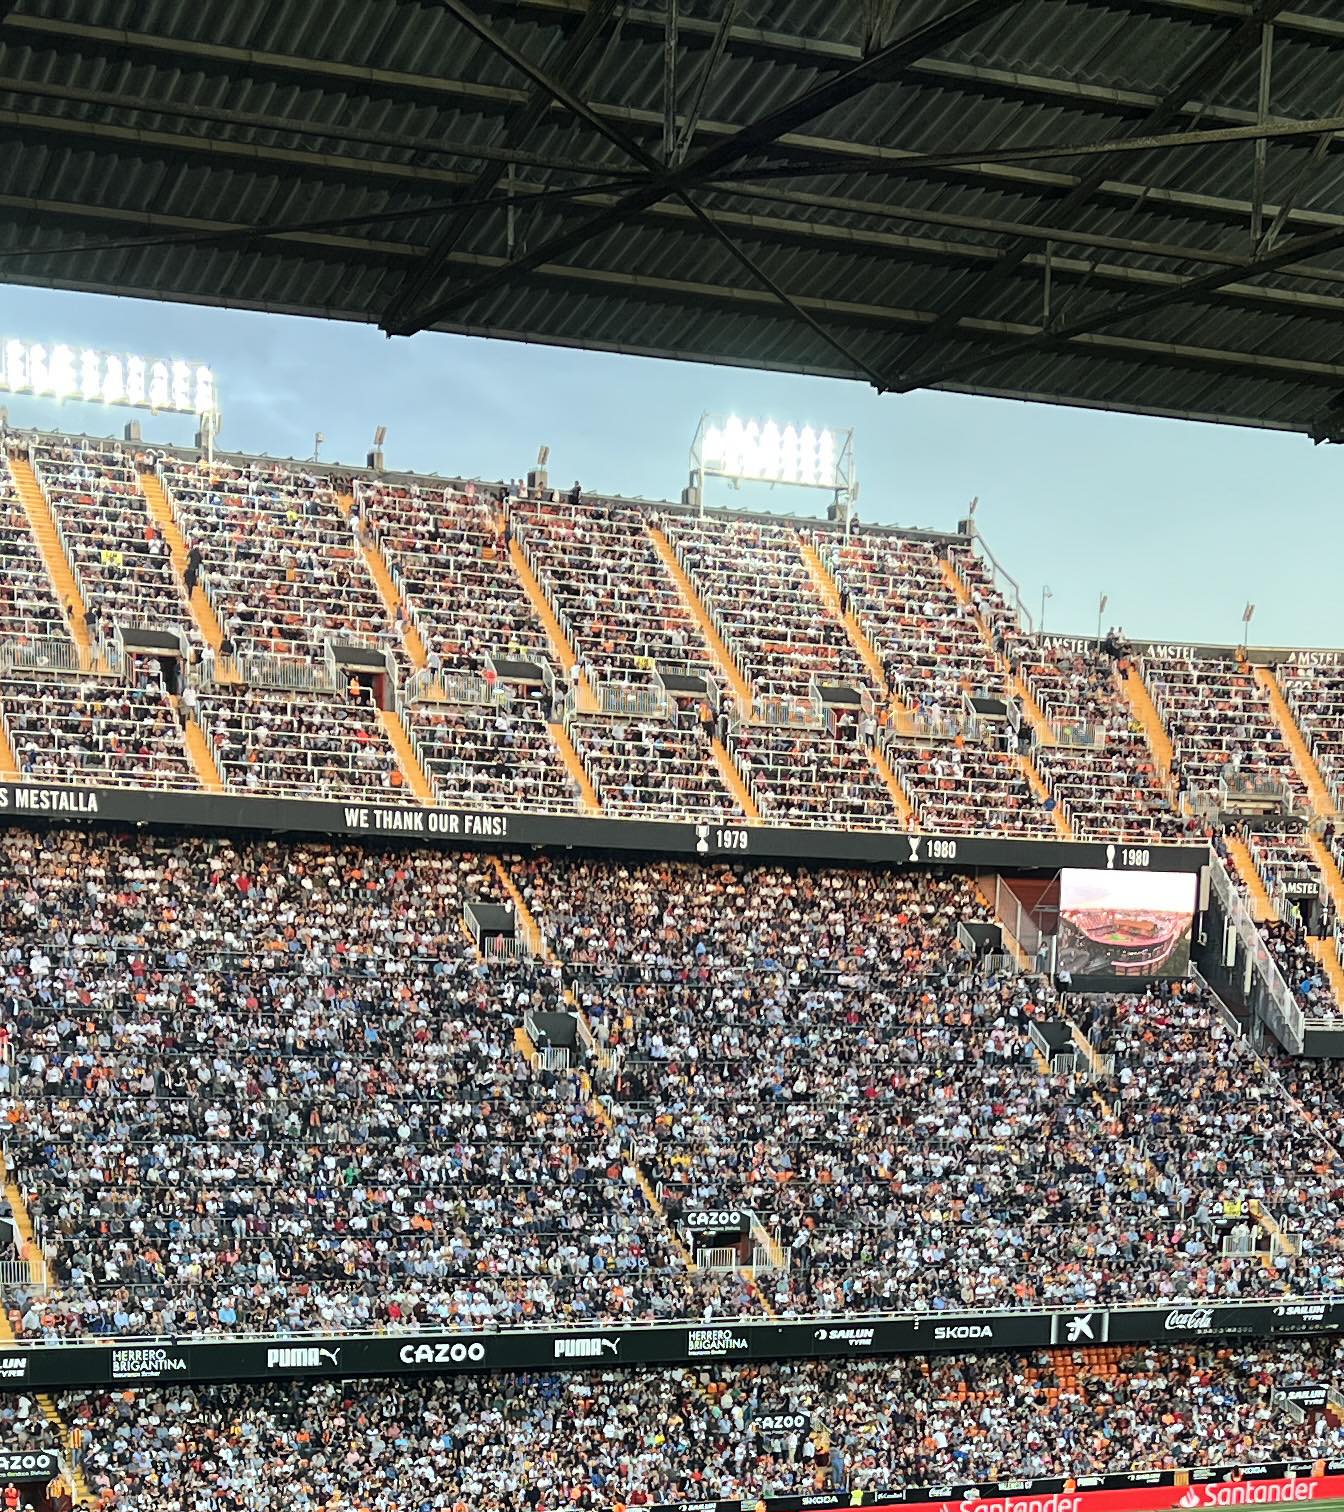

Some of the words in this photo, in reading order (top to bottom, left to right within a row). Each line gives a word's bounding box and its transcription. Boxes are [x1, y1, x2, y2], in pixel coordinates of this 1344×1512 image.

[1148, 645, 1197, 659] AMSTEL
[15, 789, 98, 813] MESTALLA
[344, 807, 369, 828] WE
[373, 809, 422, 831] THANK
[427, 813, 460, 834] OUR
[464, 814, 508, 836] FANS!
[716, 829, 748, 849] 1979
[926, 839, 956, 859] 1980
[1122, 848, 1150, 867] 1980
[1280, 881, 1319, 894] AMSTEL
[687, 1212, 740, 1226] CAZOO
[1164, 1308, 1214, 1330] Coca-Cola
[688, 1329, 732, 1341] HERRERO
[828, 1328, 874, 1340] SAILUN
[935, 1325, 993, 1340] SKODA
[555, 1339, 603, 1357] PUMA
[688, 1338, 748, 1350] BRIGANTINA
[113, 1349, 167, 1361] HERRERO
[268, 1347, 320, 1367] PUMA
[399, 1343, 485, 1364] CAZOO
[113, 1359, 186, 1372] BRIGANTINA
[802, 1495, 839, 1505] SKODA
[1203, 1478, 1318, 1508] Santander
